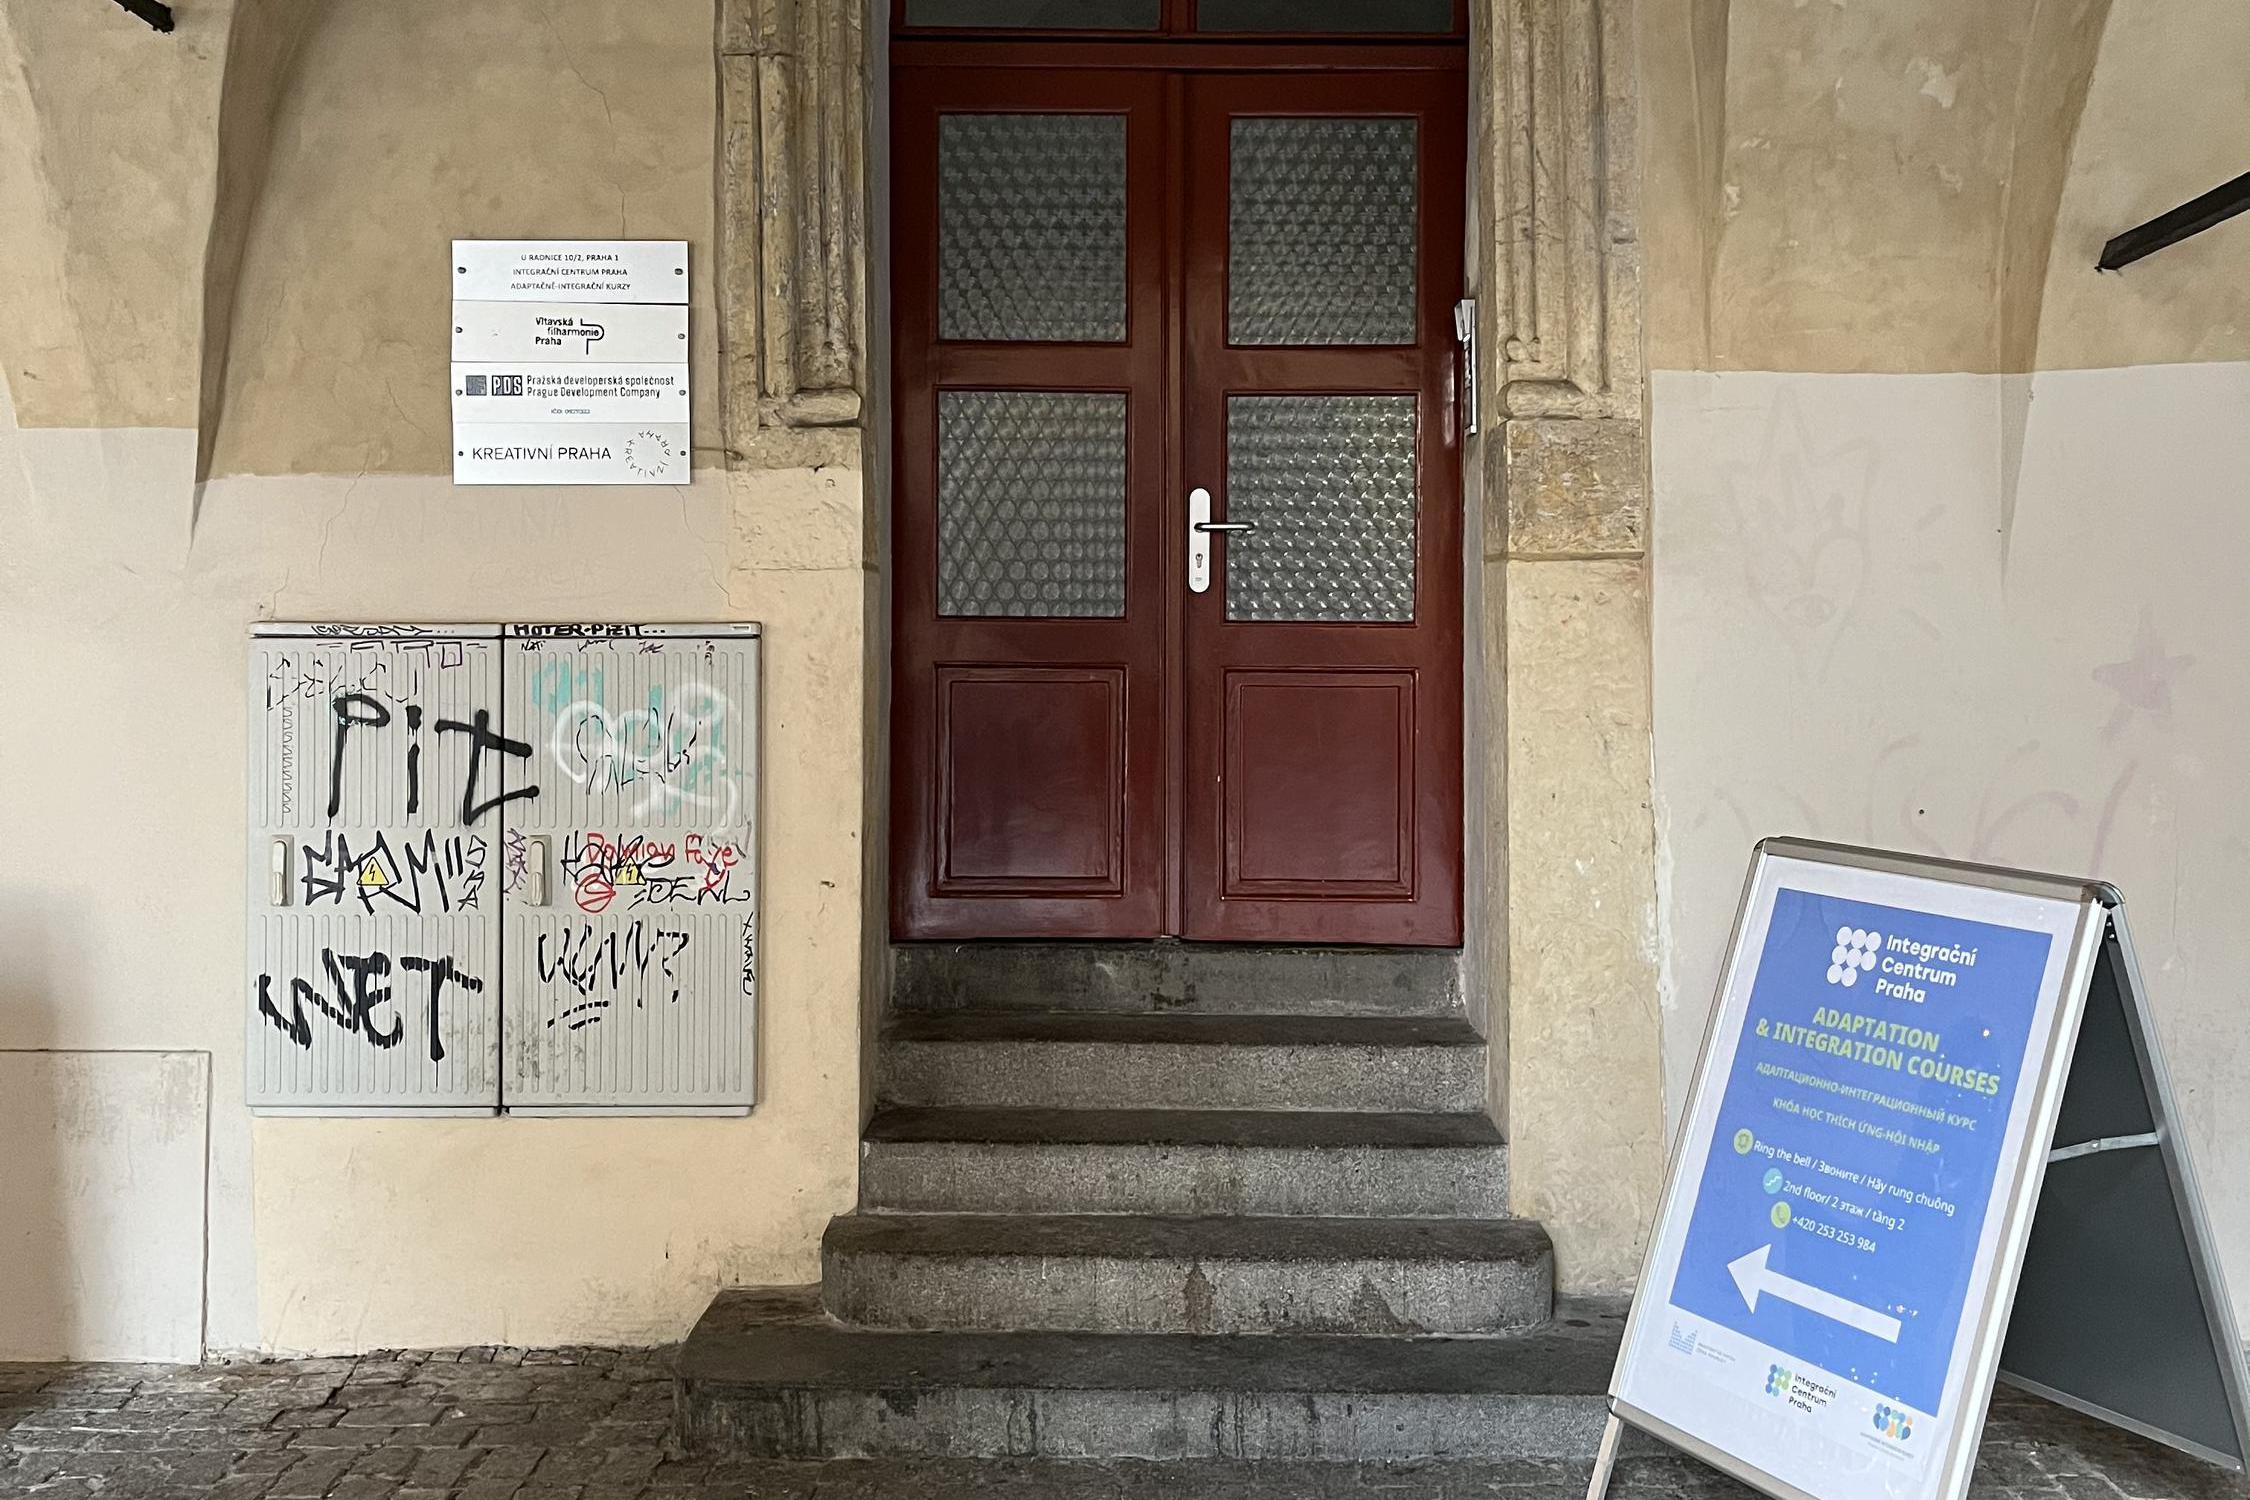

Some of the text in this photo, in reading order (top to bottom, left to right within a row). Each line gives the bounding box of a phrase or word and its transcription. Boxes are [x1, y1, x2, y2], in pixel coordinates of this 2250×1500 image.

[564, 254, 584, 262] 10/2,
[512, 267, 628, 276] INTEGRAČNÍ CENTRUM PRAHA
[605, 282, 631, 290] KURZY
[535, 317, 574, 327] Vltavská
[547, 326, 600, 337] filharmonie
[535, 336, 562, 346] Praha
[491, 375, 523, 396] PDS
[526, 375, 675, 387] Pražská developerská společnost
[526, 387, 661, 399] Prague Development Company
[472, 443, 612, 460] KREATIVNÍ PRAHA
[1886, 934, 1979, 967] Integrační
[1881, 957, 1957, 987] Centrum
[1875, 978, 1926, 1003] Praha
[1812, 1006, 1940, 1053] ADAPTATION
[1756, 1018, 2000, 1096] & INTEGRATION COURSES
[1755, 1062, 1978, 1132] АДАПТАЦИОННО-ИНТЕГРАЦИОННЫЙ КУРС
[1772, 1097, 1801, 1115] KHÓA
[1825, 1111, 1856, 1132] THÍCH
[1753, 1140, 1775, 1158] Ring
[1776, 1147, 1792, 1162] the
[1793, 1151, 1812, 1168] bell
[1818, 1160, 1860, 1184] Звоните
[1867, 1175, 1887, 1195] Hãy
[1888, 1186, 1913, 1204] rung
[1915, 1191, 1956, 1218] chuông
[1783, 1180, 1802, 1197] 2nd
[1831, 1196, 1839, 1209] 2
[1839, 1201, 1863, 1217] этаж
[1896, 1218, 1906, 1231] 2
[1792, 1215, 1876, 1253] +420 253 253 984
[1791, 1385, 1827, 1408] Centrum
[1795, 1373, 1837, 1400] Integrační
[1788, 1396, 1813, 1413] Praha
